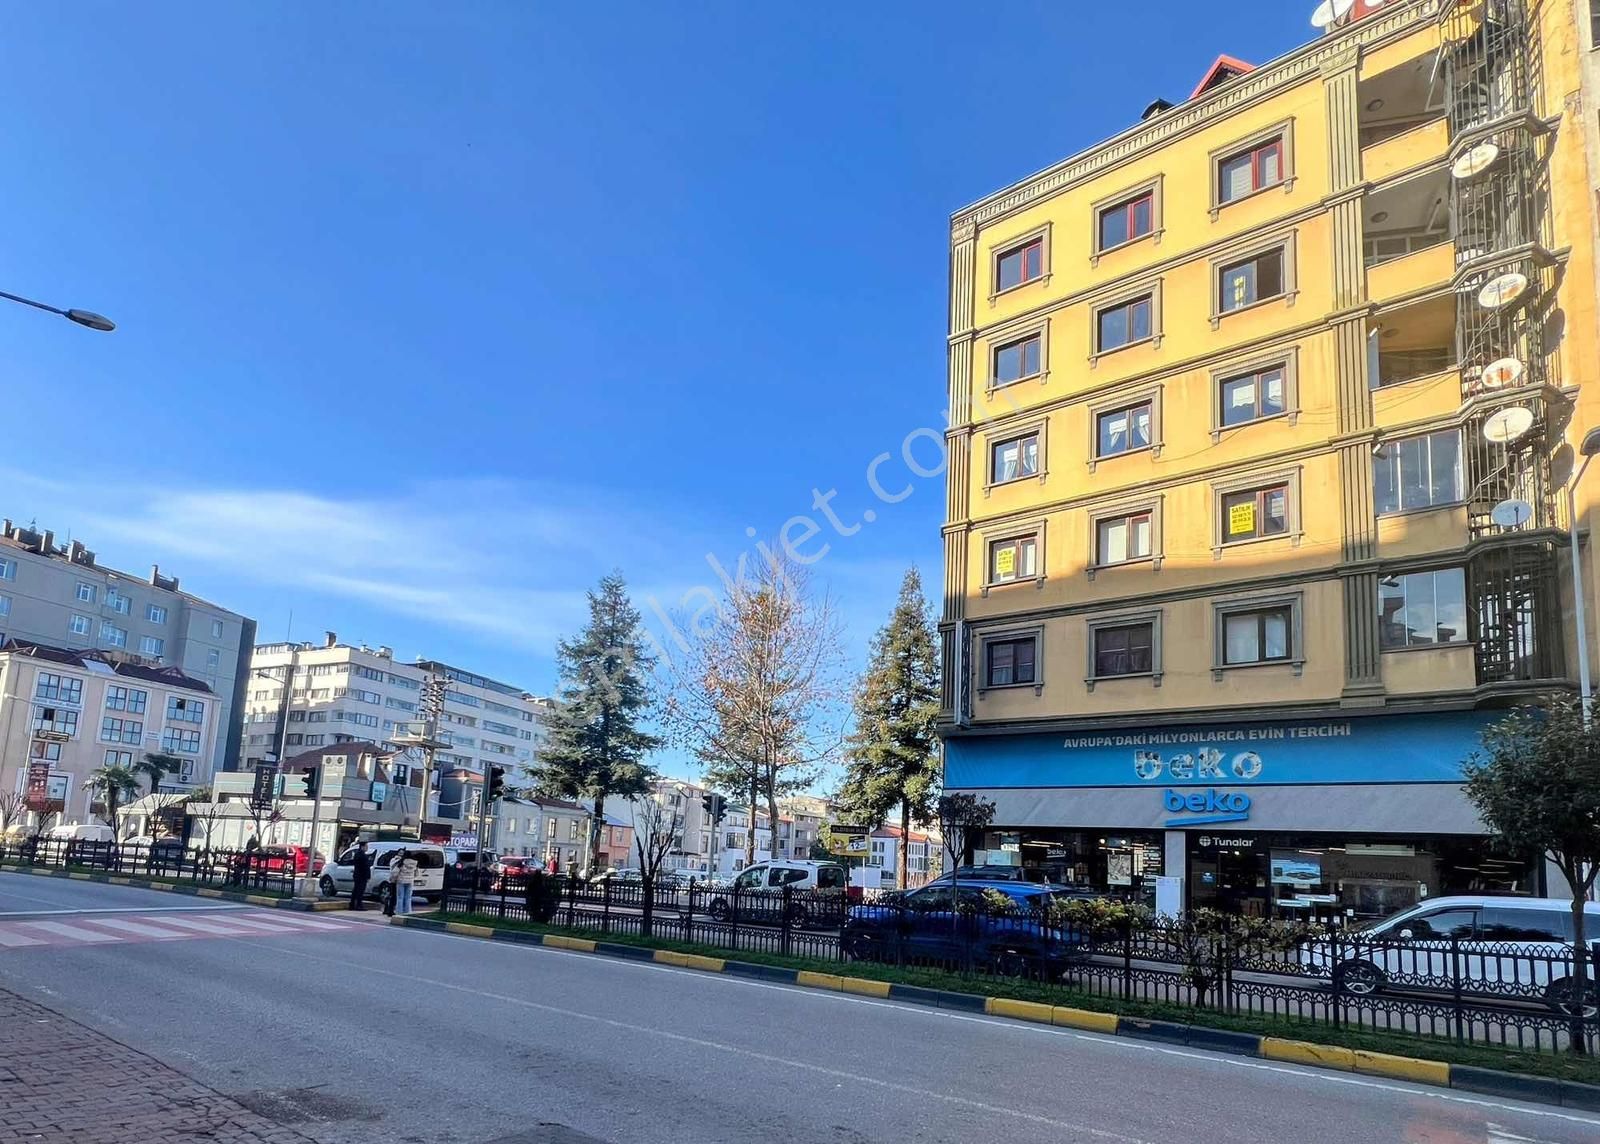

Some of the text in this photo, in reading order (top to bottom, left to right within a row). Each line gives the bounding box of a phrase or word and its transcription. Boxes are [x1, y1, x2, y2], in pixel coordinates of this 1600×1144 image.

[1063, 723, 1351, 749] AVRUPA'DAKİ MİLYONLARCA EVİN TERCİHİ
[1134, 747, 1264, 780] beko
[260, 767, 271, 800] HOTEL
[1164, 788, 1252, 813] beko
[1212, 836, 1254, 847] Tunalar
